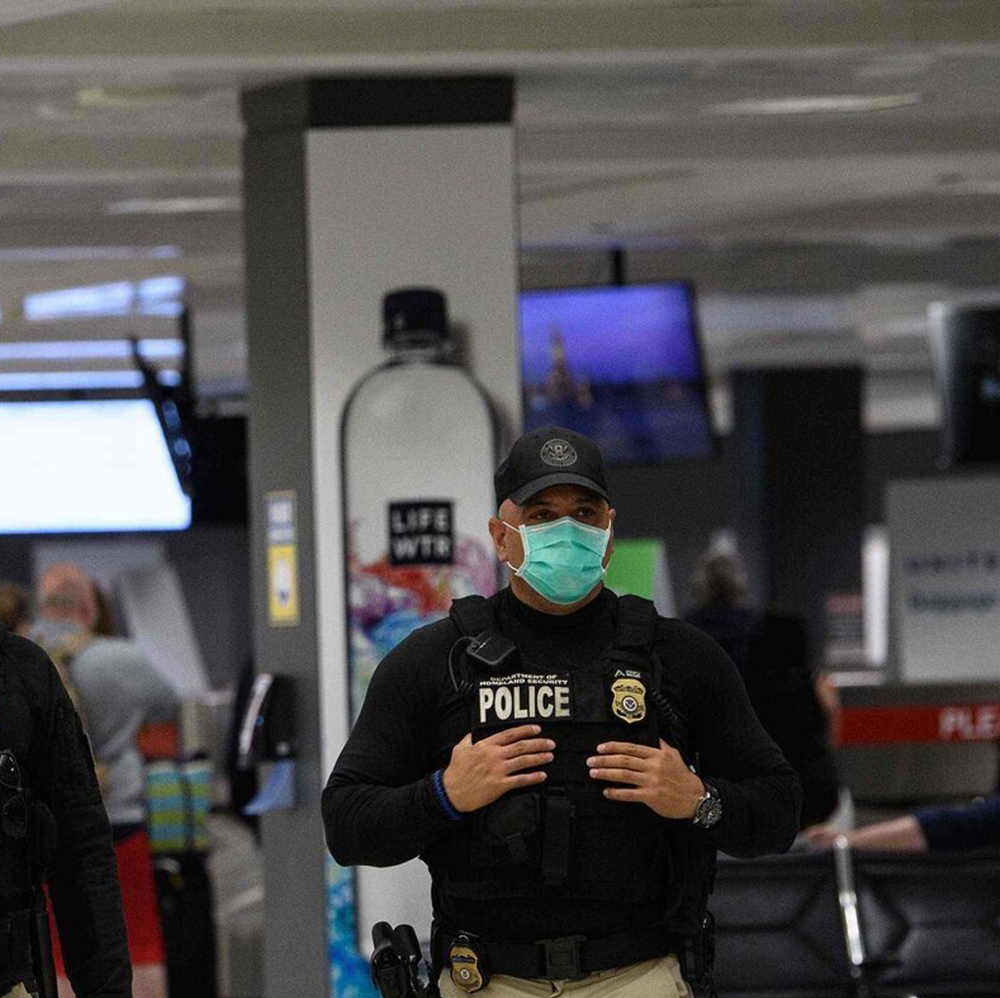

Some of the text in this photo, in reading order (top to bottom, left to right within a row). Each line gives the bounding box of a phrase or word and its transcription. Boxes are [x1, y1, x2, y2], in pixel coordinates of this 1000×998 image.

[391, 508, 449, 533] LIFE
[391, 535, 451, 559] WTR
[489, 673, 544, 681] DEPARTMENT
[479, 685, 570, 723] POLICE
